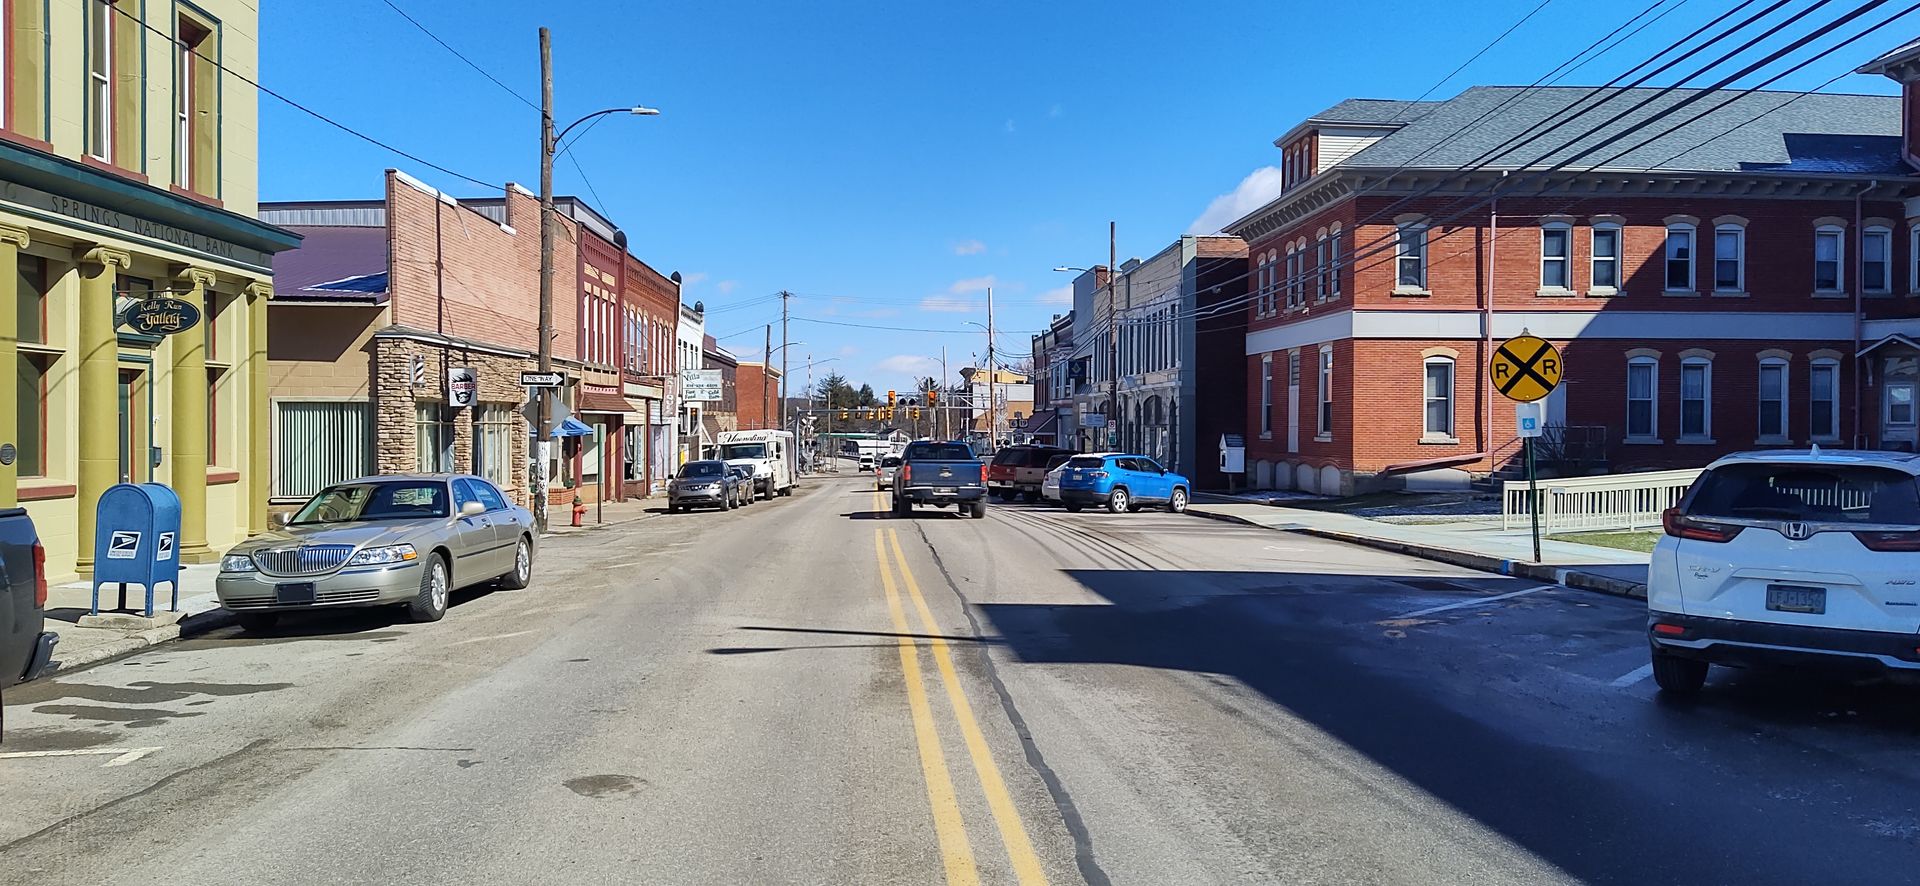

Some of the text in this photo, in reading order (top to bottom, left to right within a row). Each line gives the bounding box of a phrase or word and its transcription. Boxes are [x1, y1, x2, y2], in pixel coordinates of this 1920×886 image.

[51, 197, 234, 258] SPRINGS NATIONAL BANK
[140, 301, 182, 312] Kelly Run
[137, 311, 187, 331] Gallery
[1495, 359, 1557, 379] R R
